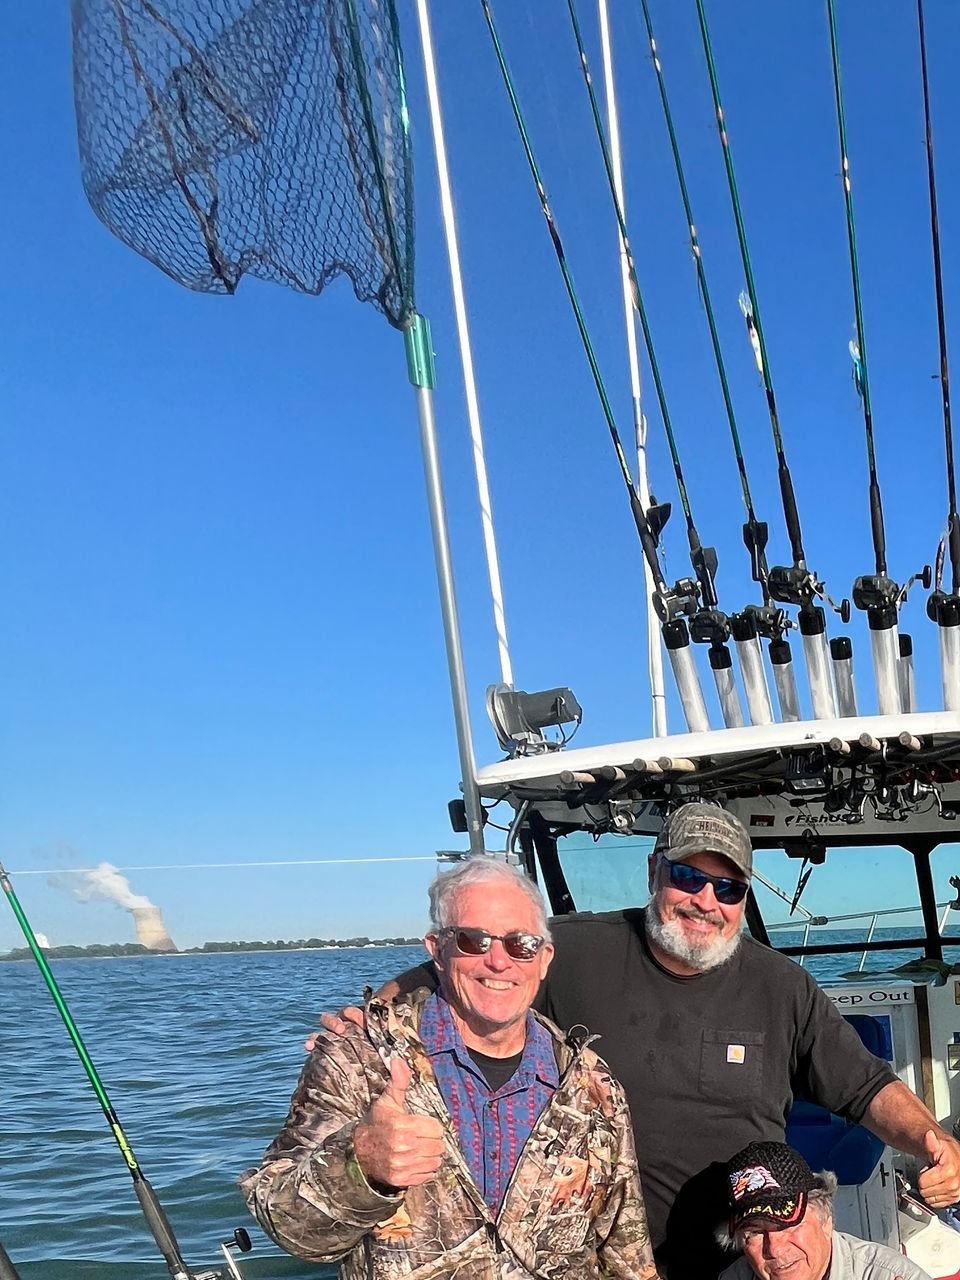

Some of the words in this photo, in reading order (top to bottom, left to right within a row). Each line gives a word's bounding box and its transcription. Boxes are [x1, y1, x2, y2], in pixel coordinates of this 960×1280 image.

[828, 995, 863, 1005] eep
[869, 991, 909, 1001] Out
[743, 1205, 773, 1217] USA
